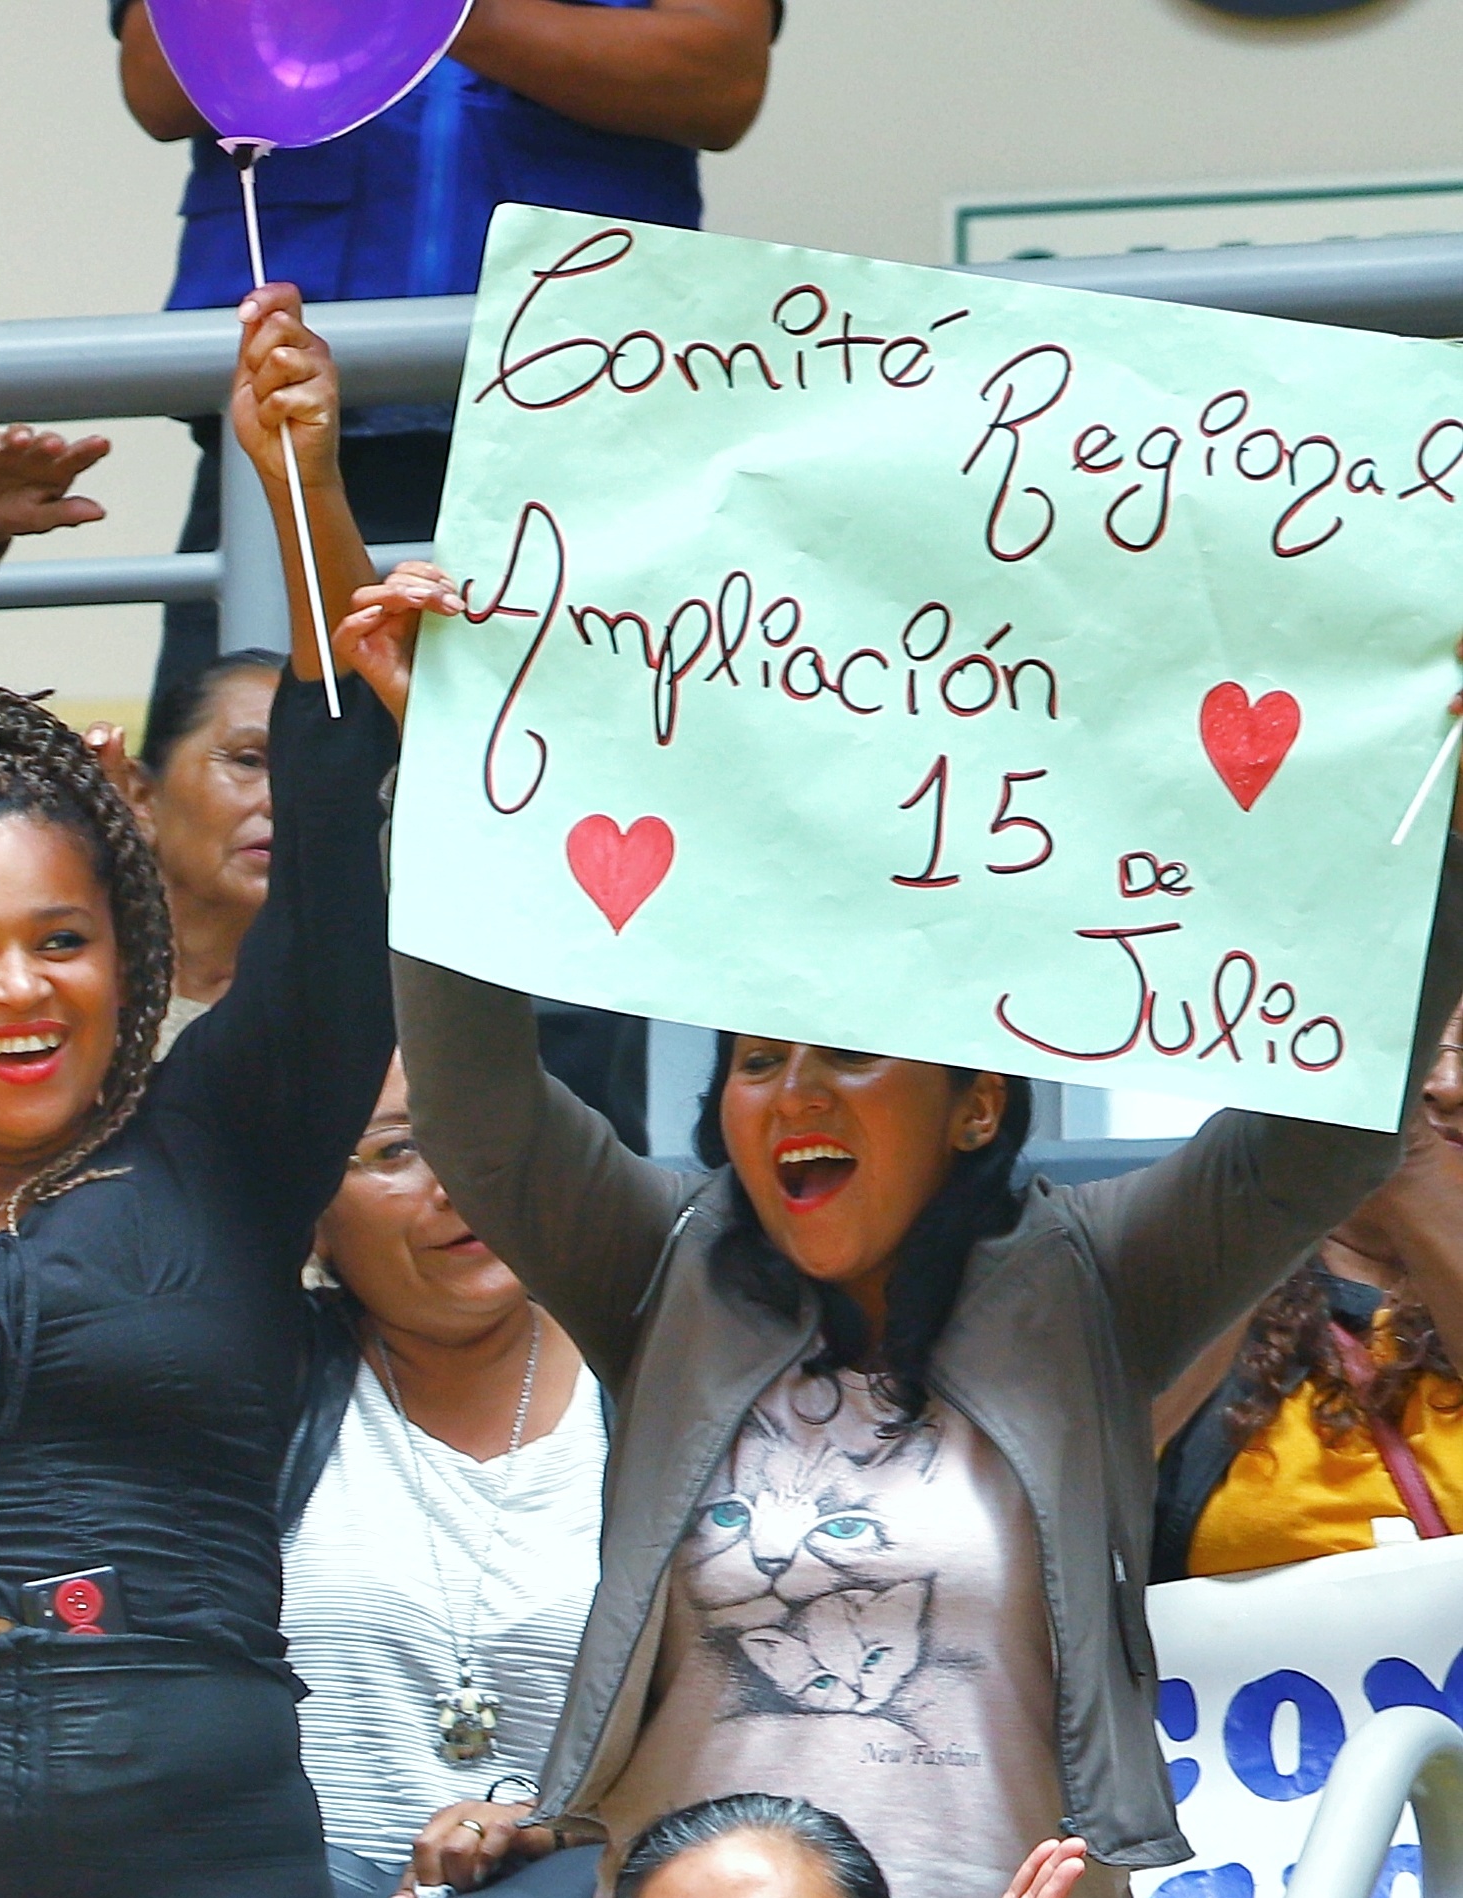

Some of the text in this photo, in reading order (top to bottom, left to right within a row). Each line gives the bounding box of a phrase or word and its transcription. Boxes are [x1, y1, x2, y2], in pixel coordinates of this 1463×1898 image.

[474, 227, 1463, 563] Comité Regional
[460, 501, 1059, 815] Ampliación
[890, 754, 1195, 898] 15 De
[995, 921, 1344, 1072] Julio
